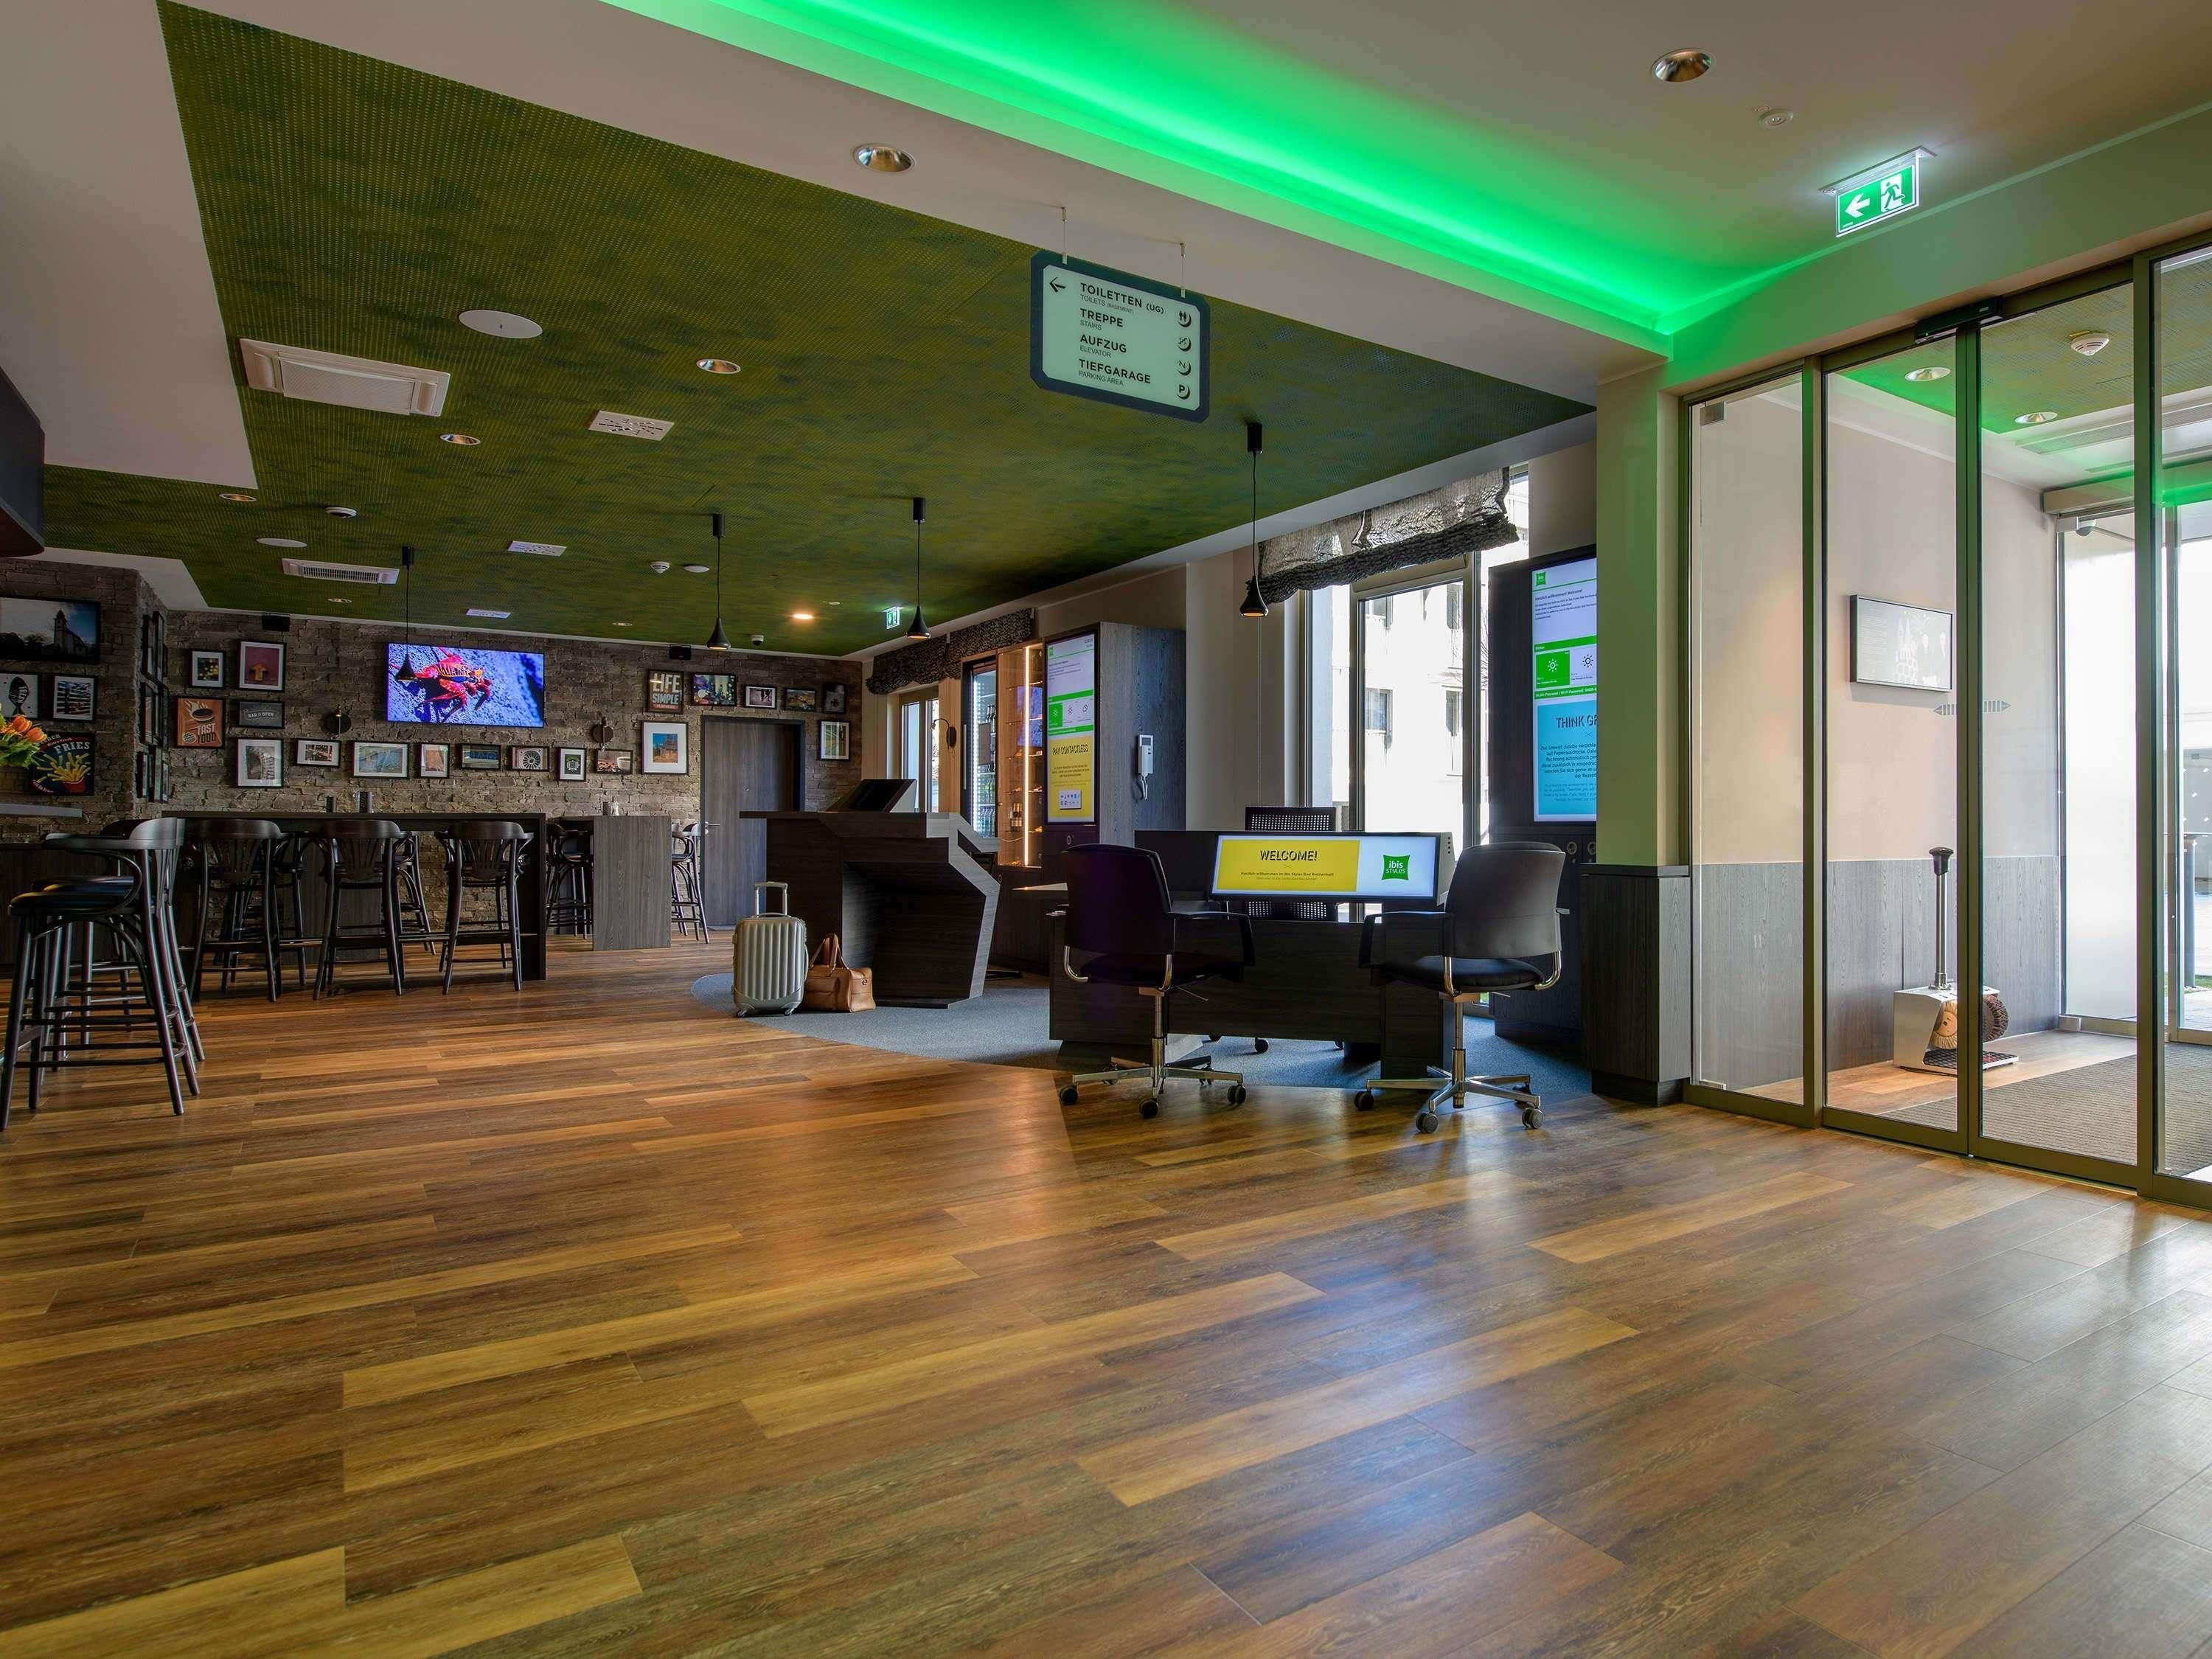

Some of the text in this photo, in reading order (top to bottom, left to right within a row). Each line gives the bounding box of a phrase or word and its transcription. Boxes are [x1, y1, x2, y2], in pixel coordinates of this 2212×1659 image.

[1080, 282, 1165, 314] TOILETTEN (UG)
[1080, 294, 1106, 306] TOILETS
[1080, 308, 1123, 327] TREPPE
[1080, 319, 1102, 330] STAIRS
[1080, 334, 1127, 352] AUFZUG
[1079, 345, 1111, 358] ELEVATOR
[1079, 358, 1150, 383] TIEFGARAGE
[1079, 370, 1124, 386] PARKING AREA
[652, 693, 679, 704] SIMPLE
[1556, 715, 1585, 728] THINK
[54, 742, 90, 754] FRIES
[1260, 850, 1318, 861] WELCOME!
[1389, 860, 1403, 869] ibis
